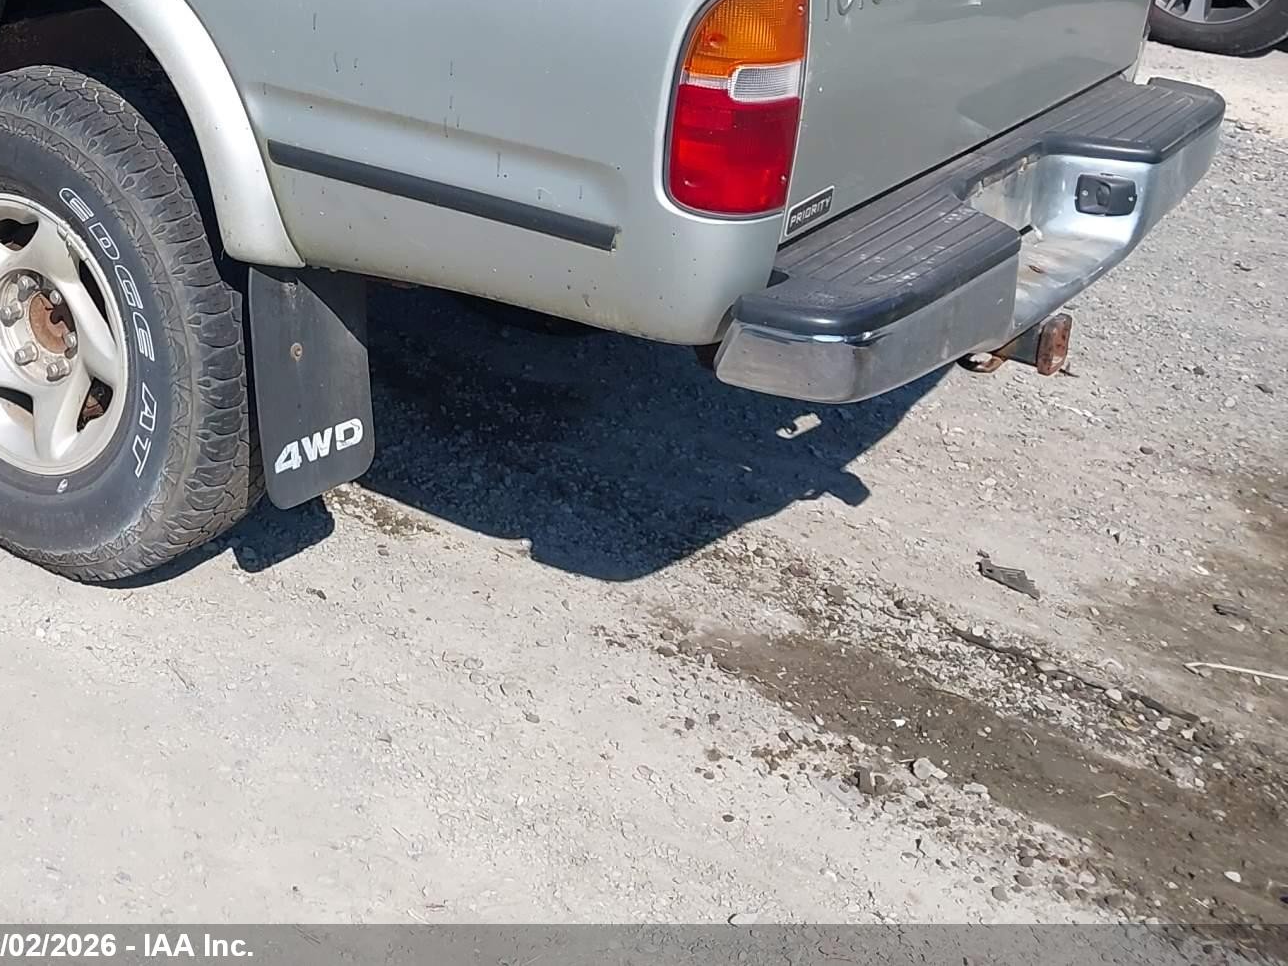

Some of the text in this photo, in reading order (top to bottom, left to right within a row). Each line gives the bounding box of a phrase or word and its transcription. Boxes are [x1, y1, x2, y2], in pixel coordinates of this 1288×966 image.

[789, 195, 832, 228] PRIORITY
[58, 187, 158, 478] EDGE AT
[274, 417, 364, 474] 4WD
